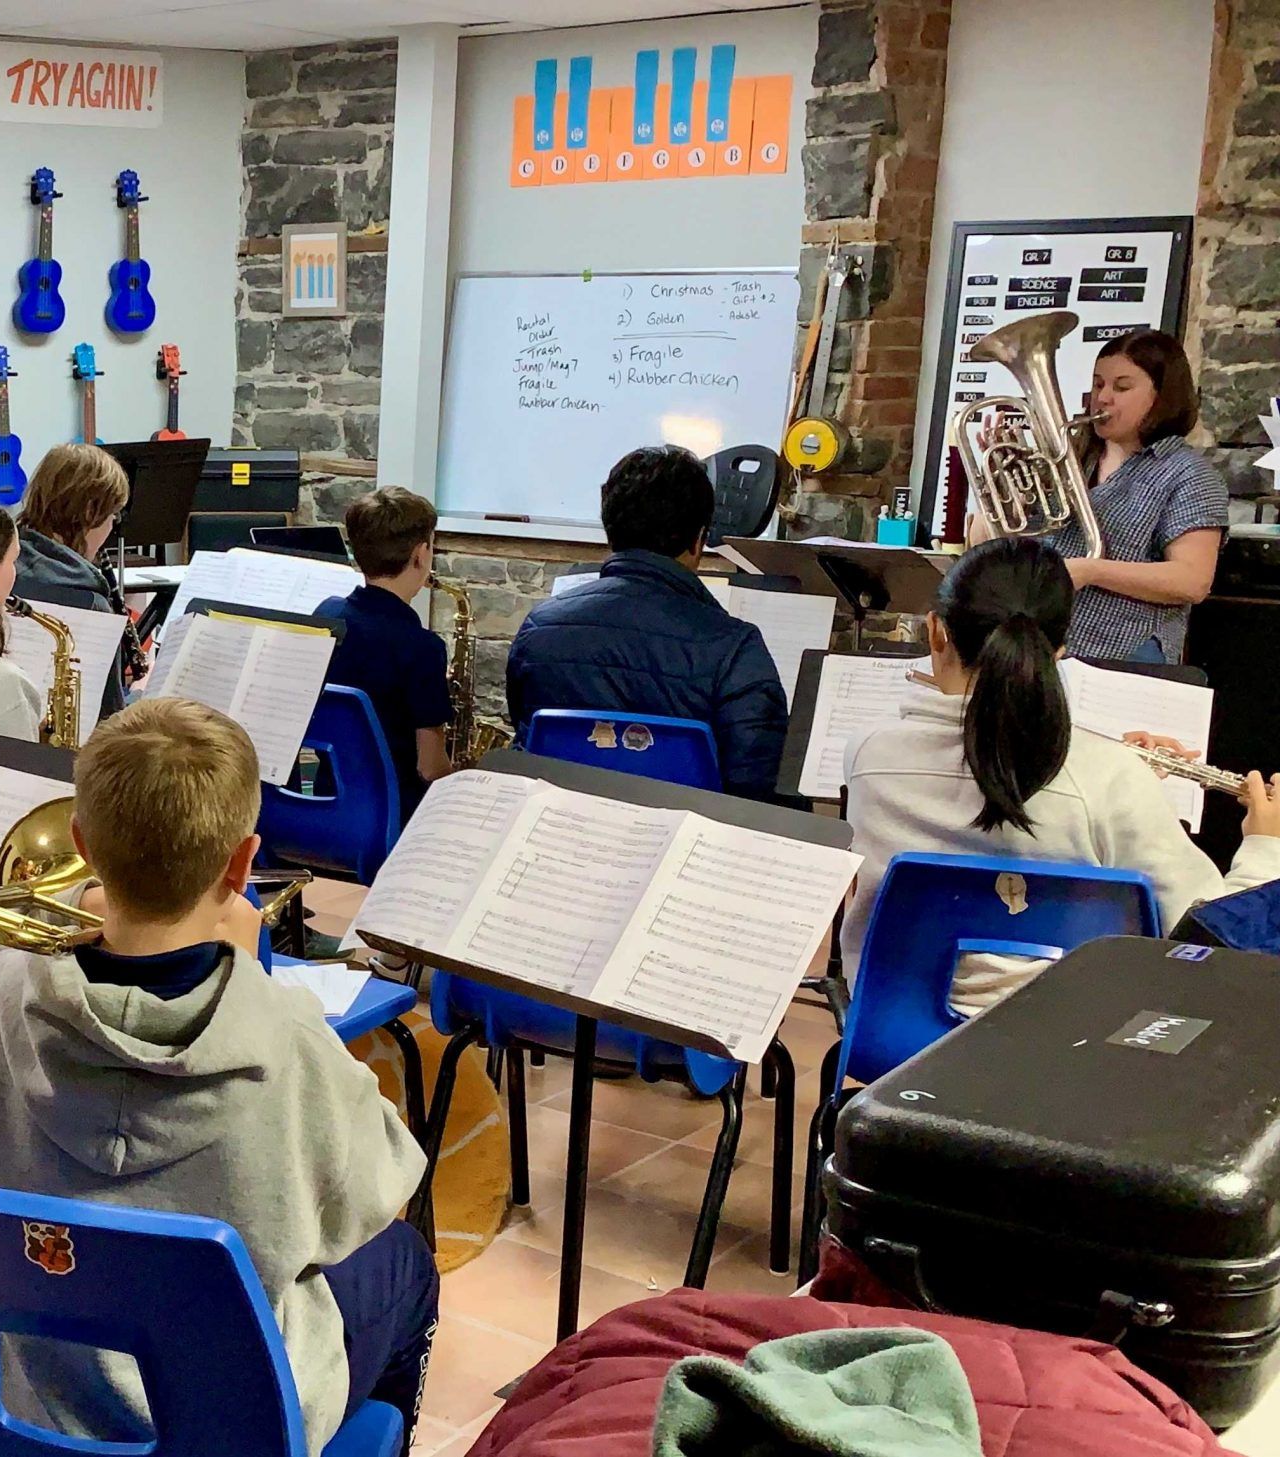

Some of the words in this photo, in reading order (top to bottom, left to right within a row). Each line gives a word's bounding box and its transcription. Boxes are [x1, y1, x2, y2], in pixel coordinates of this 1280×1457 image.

[6, 58, 69, 106] TRY
[67, 62, 157, 111] AGAIN!
[522, 161, 532, 174] C
[554, 159, 565, 171] D
[655, 152, 666, 166] G
[729, 148, 739, 162] B
[765, 145, 776, 159] C
[1042, 252, 1049, 261] 7
[1125, 249, 1134, 259] 8
[1103, 271, 1124, 281] ART
[650, 283, 714, 298] Christmas
[731, 280, 762, 292] Trash
[1021, 280, 1058, 290] SCIENCE
[1100, 289, 1121, 299] ART
[1017, 296, 1055, 307] ENGLISH
[646, 311, 685, 326] Golden
[527, 343, 562, 359] Trash
[629, 344, 684, 369] Fragile
[517, 374, 558, 396] Fragile
[627, 367, 676, 386] Rubber
[678, 371, 739, 393] Chicken
[518, 395, 560, 409] Rubber
